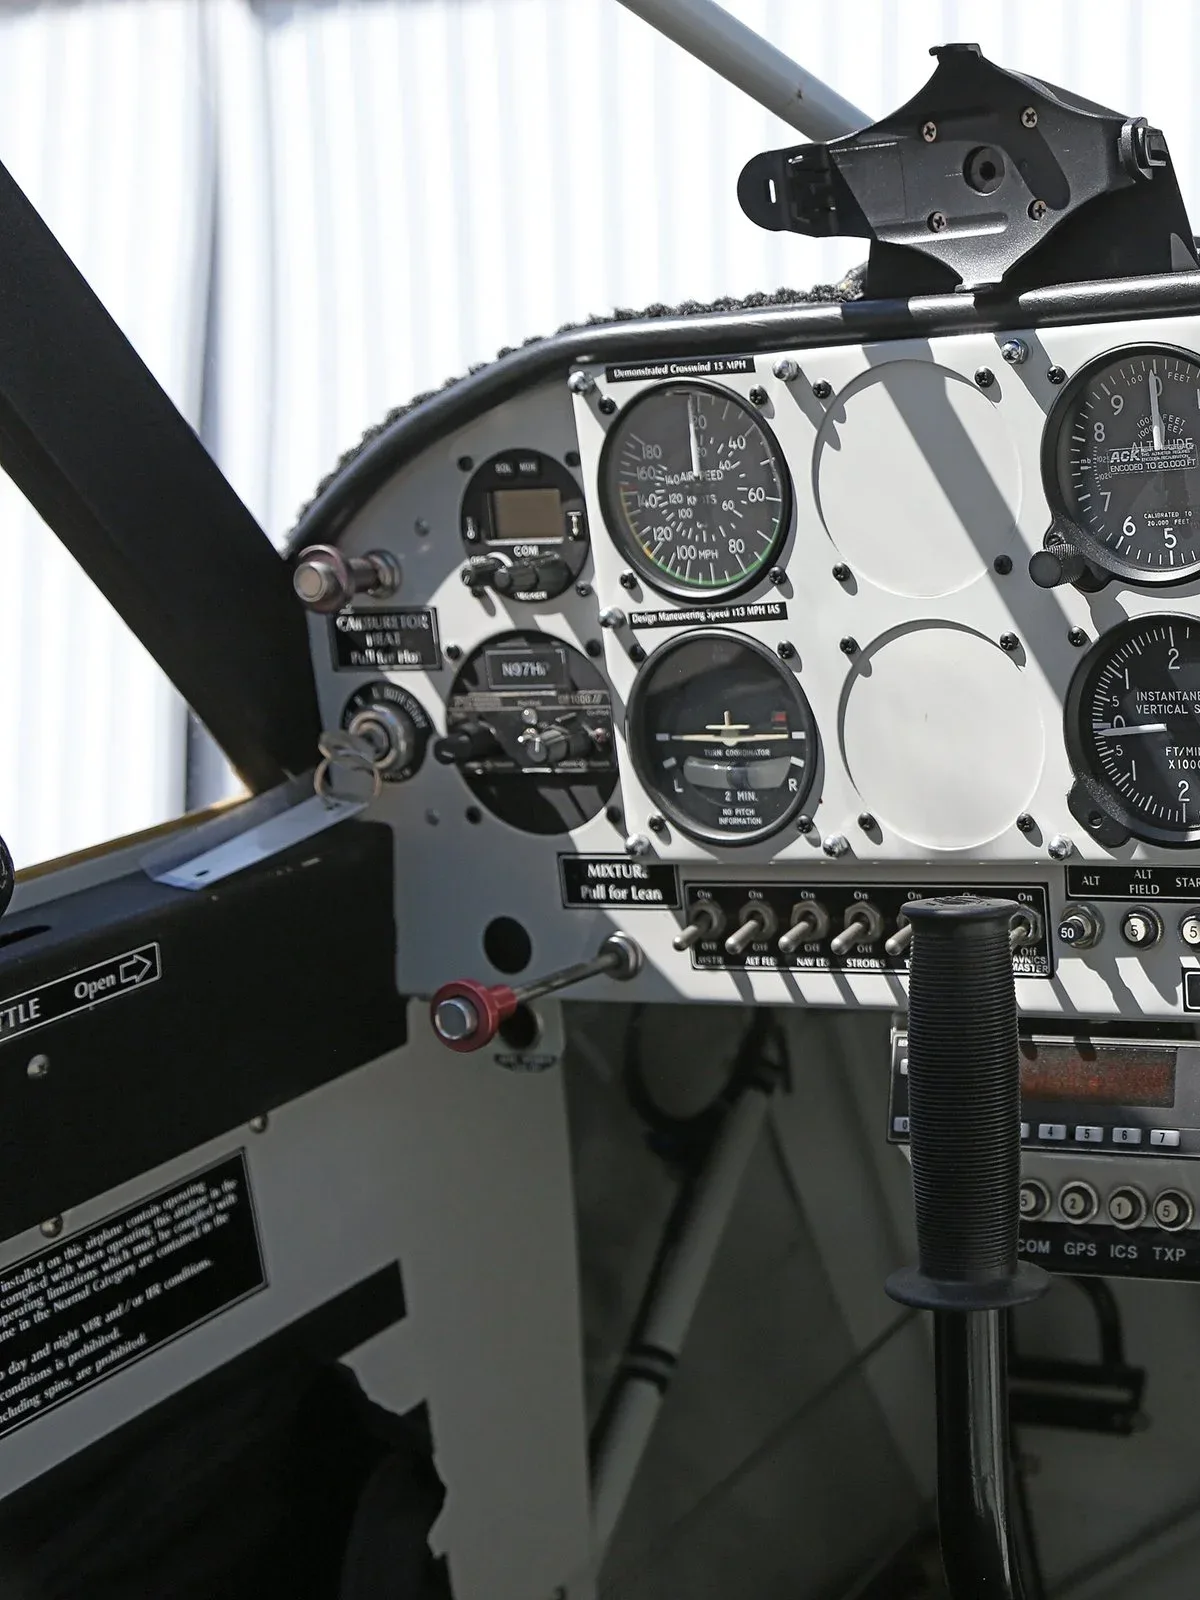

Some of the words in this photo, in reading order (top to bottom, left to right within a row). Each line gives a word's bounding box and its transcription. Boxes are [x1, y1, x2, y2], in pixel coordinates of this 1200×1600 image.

[670, 361, 711, 373] Crosswind
[725, 360, 746, 370] MPH
[1110, 394, 1124, 415] 9
[1093, 422, 1106, 442] 8
[1110, 450, 1141, 464] ACK
[1110, 463, 1144, 473] ENCODED
[1145, 461, 1157, 470] TO
[1187, 458, 1197, 467] FT
[747, 487, 766, 502] 60
[1100, 491, 1112, 512] 7
[1122, 515, 1137, 536] 6
[652, 526, 673, 542] 120
[1164, 527, 1177, 549] 5
[675, 545, 698, 560] 100
[698, 548, 719, 560] MPH
[728, 538, 746, 554] 80
[632, 611, 658, 624] Design
[658, 608, 706, 623] Maneuvering
[706, 605, 730, 620] Speed
[746, 605, 766, 616] MPH
[766, 603, 781, 615] IAS
[1168, 648, 1181, 670] 2
[1135, 704, 1189, 715] VERTICAL
[788, 778, 799, 793] R
[1178, 780, 1191, 802] 2
[734, 808, 755, 817] PITCH
[718, 817, 762, 826] INFORMATION
[588, 863, 649, 879] MIXTUR
[1134, 869, 1153, 880] ALT
[1081, 875, 1101, 886] ALT
[580, 885, 606, 901] Pull
[608, 884, 629, 900] for
[630, 885, 663, 901] Lean
[1129, 884, 1160, 895] FIELD
[1060, 927, 1075, 939] 50
[73, 973, 117, 1001] Open
[1063, 1241, 1098, 1258] GPS
[1110, 1244, 1139, 1260] ICS
[1152, 1246, 1187, 1263] TXP
[92, 1262, 136, 1293] Category
